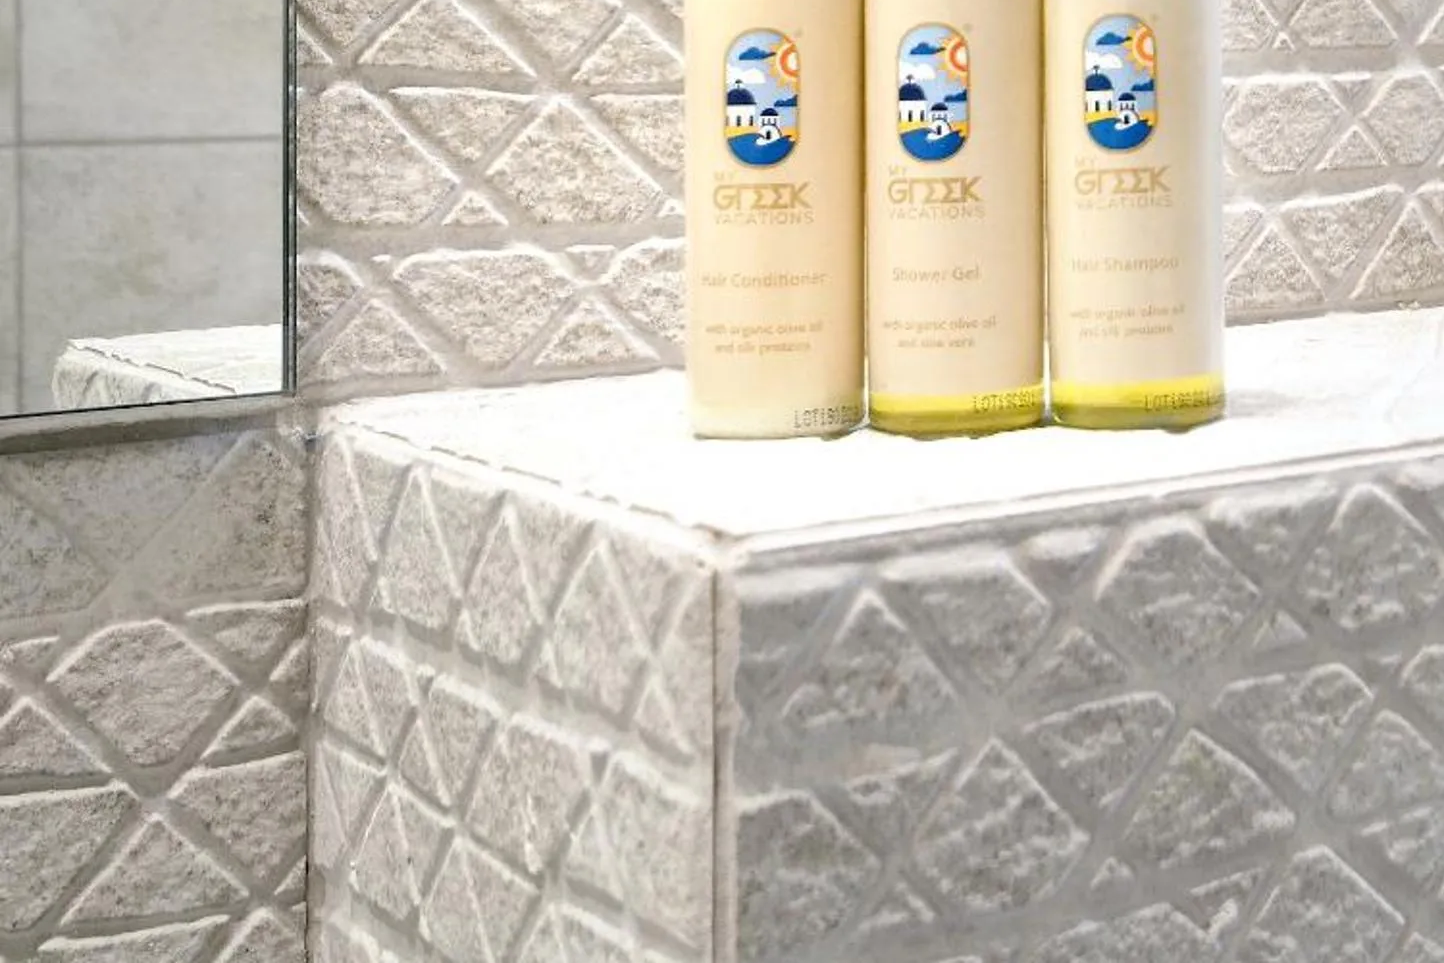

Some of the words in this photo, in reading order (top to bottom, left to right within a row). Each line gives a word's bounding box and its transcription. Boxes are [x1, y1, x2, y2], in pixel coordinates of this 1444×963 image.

[1075, 194, 1174, 210] VACATIONS
[713, 210, 815, 225] VACATIONS
[888, 205, 987, 220] VACATIONS
[1071, 259, 1099, 272] Hair
[1104, 256, 1180, 274] Shampoo
[731, 272, 828, 288] Conditioner
[892, 267, 947, 283] Shower
[952, 265, 980, 282] Gel
